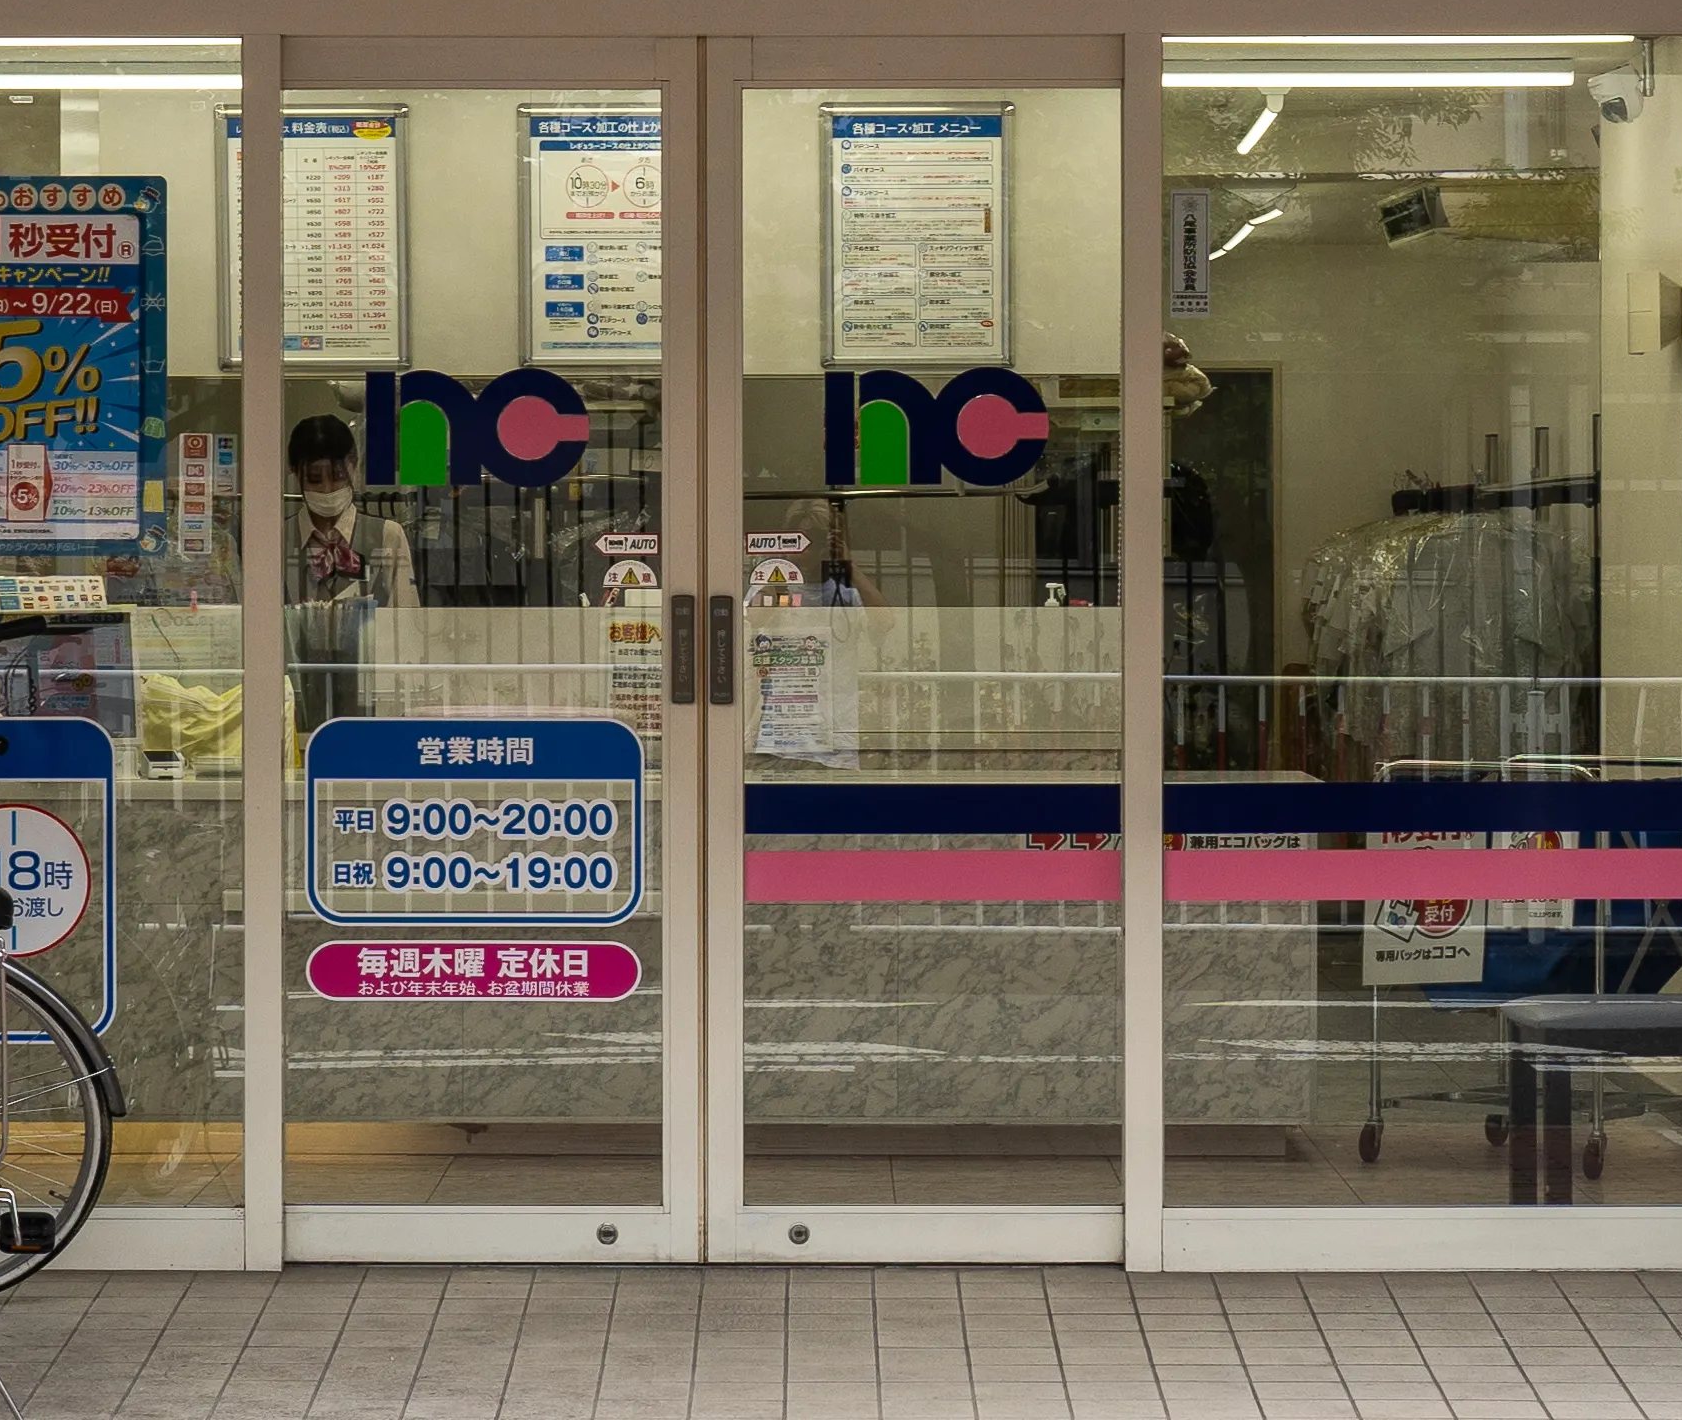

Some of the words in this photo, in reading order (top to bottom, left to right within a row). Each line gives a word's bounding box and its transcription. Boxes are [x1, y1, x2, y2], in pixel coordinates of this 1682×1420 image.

[939, 123, 981, 134] メニュー
[365, 368, 589, 486] nc
[825, 366, 1049, 486] nc
[630, 538, 656, 549] AUTO
[749, 537, 776, 549] AUTO
[608, 573, 619, 583] 注
[754, 571, 764, 580] 注
[610, 623, 662, 643] お客様へ
[417, 737, 535, 766] 営業時間
[335, 810, 375, 832] 平日
[1189, 836, 1301, 849] 兼用エコバッグは
[334, 863, 374, 886] 日祝
[1425, 906, 1455, 924] 受付
[1376, 946, 1471, 962] 専用バッグはココへ
[357, 948, 485, 979] 毎週木曜
[497, 948, 589, 978] 定休日
[358, 980, 590, 997] および年末年始、お盆期間休業
